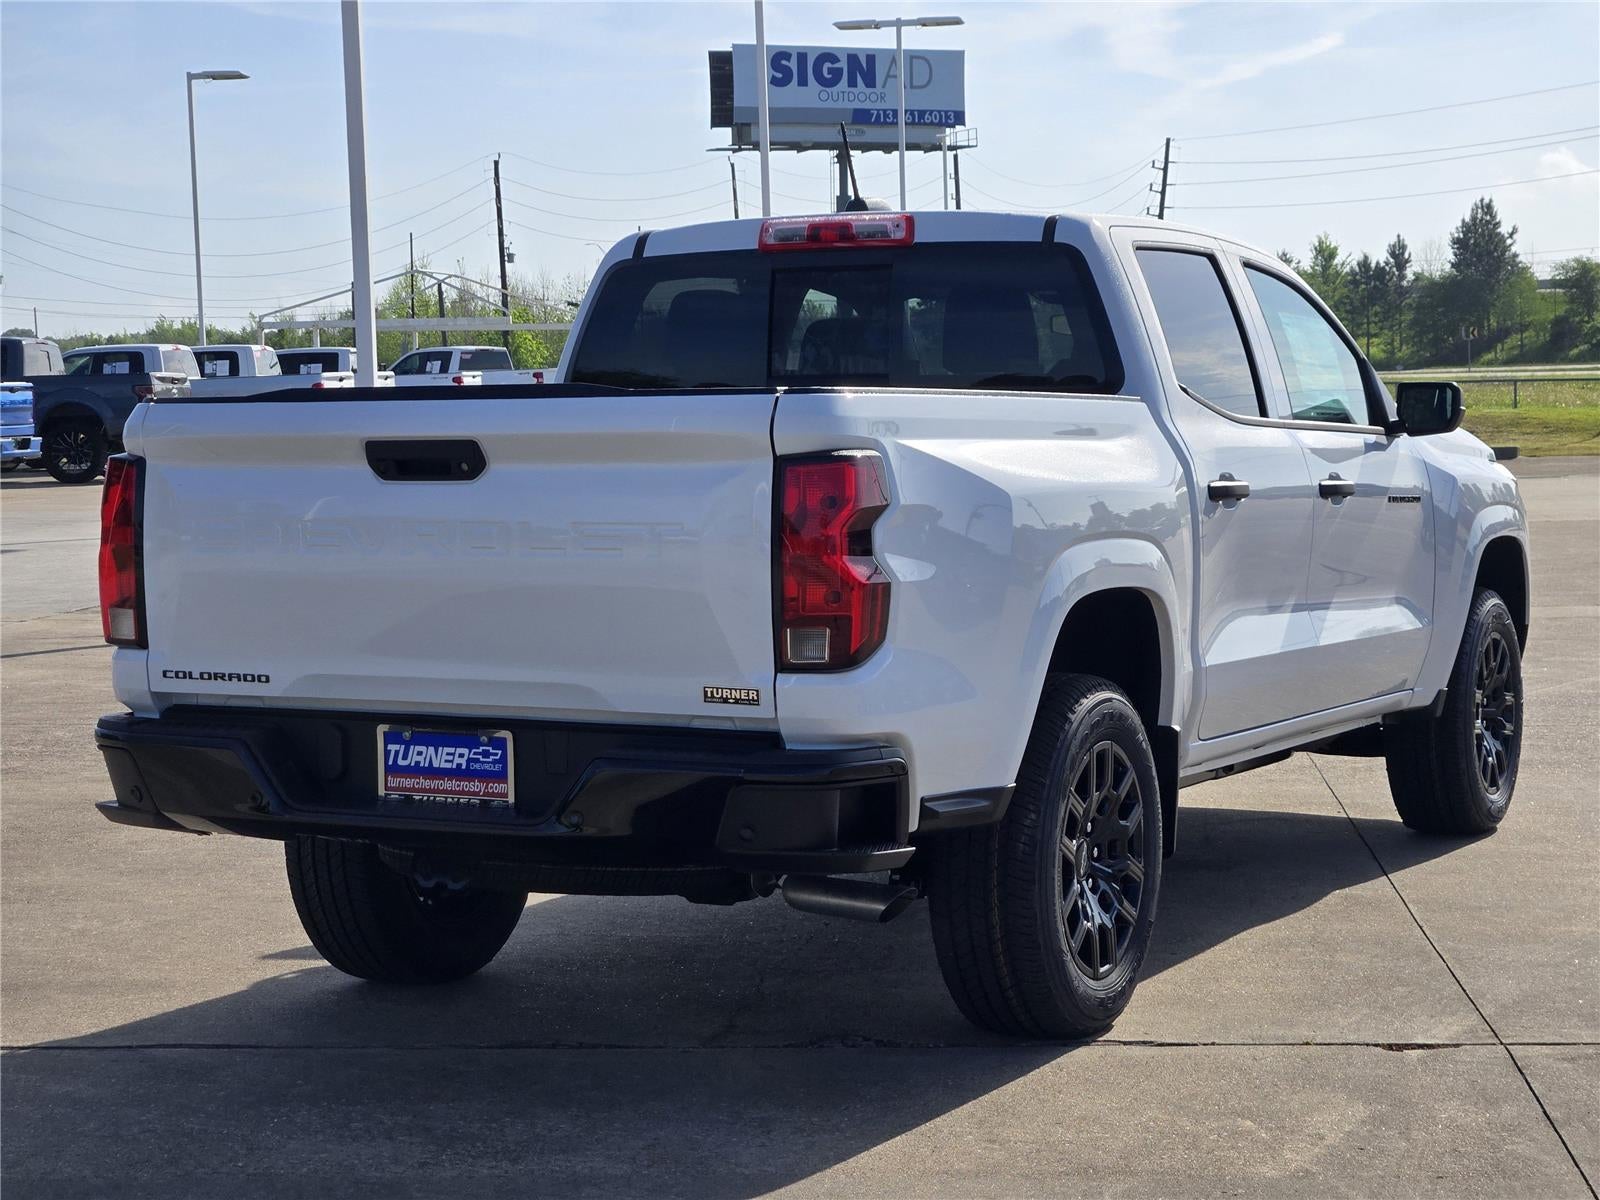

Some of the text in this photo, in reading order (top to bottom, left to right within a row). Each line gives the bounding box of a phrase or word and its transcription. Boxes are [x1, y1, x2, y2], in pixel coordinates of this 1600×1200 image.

[870, 109, 955, 124] 713.61.6013
[162, 669, 270, 684] COLORADO
[704, 687, 758, 700] TURNER
[387, 744, 470, 769] TURNER
[470, 763, 503, 771] CHEVROLET
[387, 775, 508, 795] turnerchevroletcrosby.com
